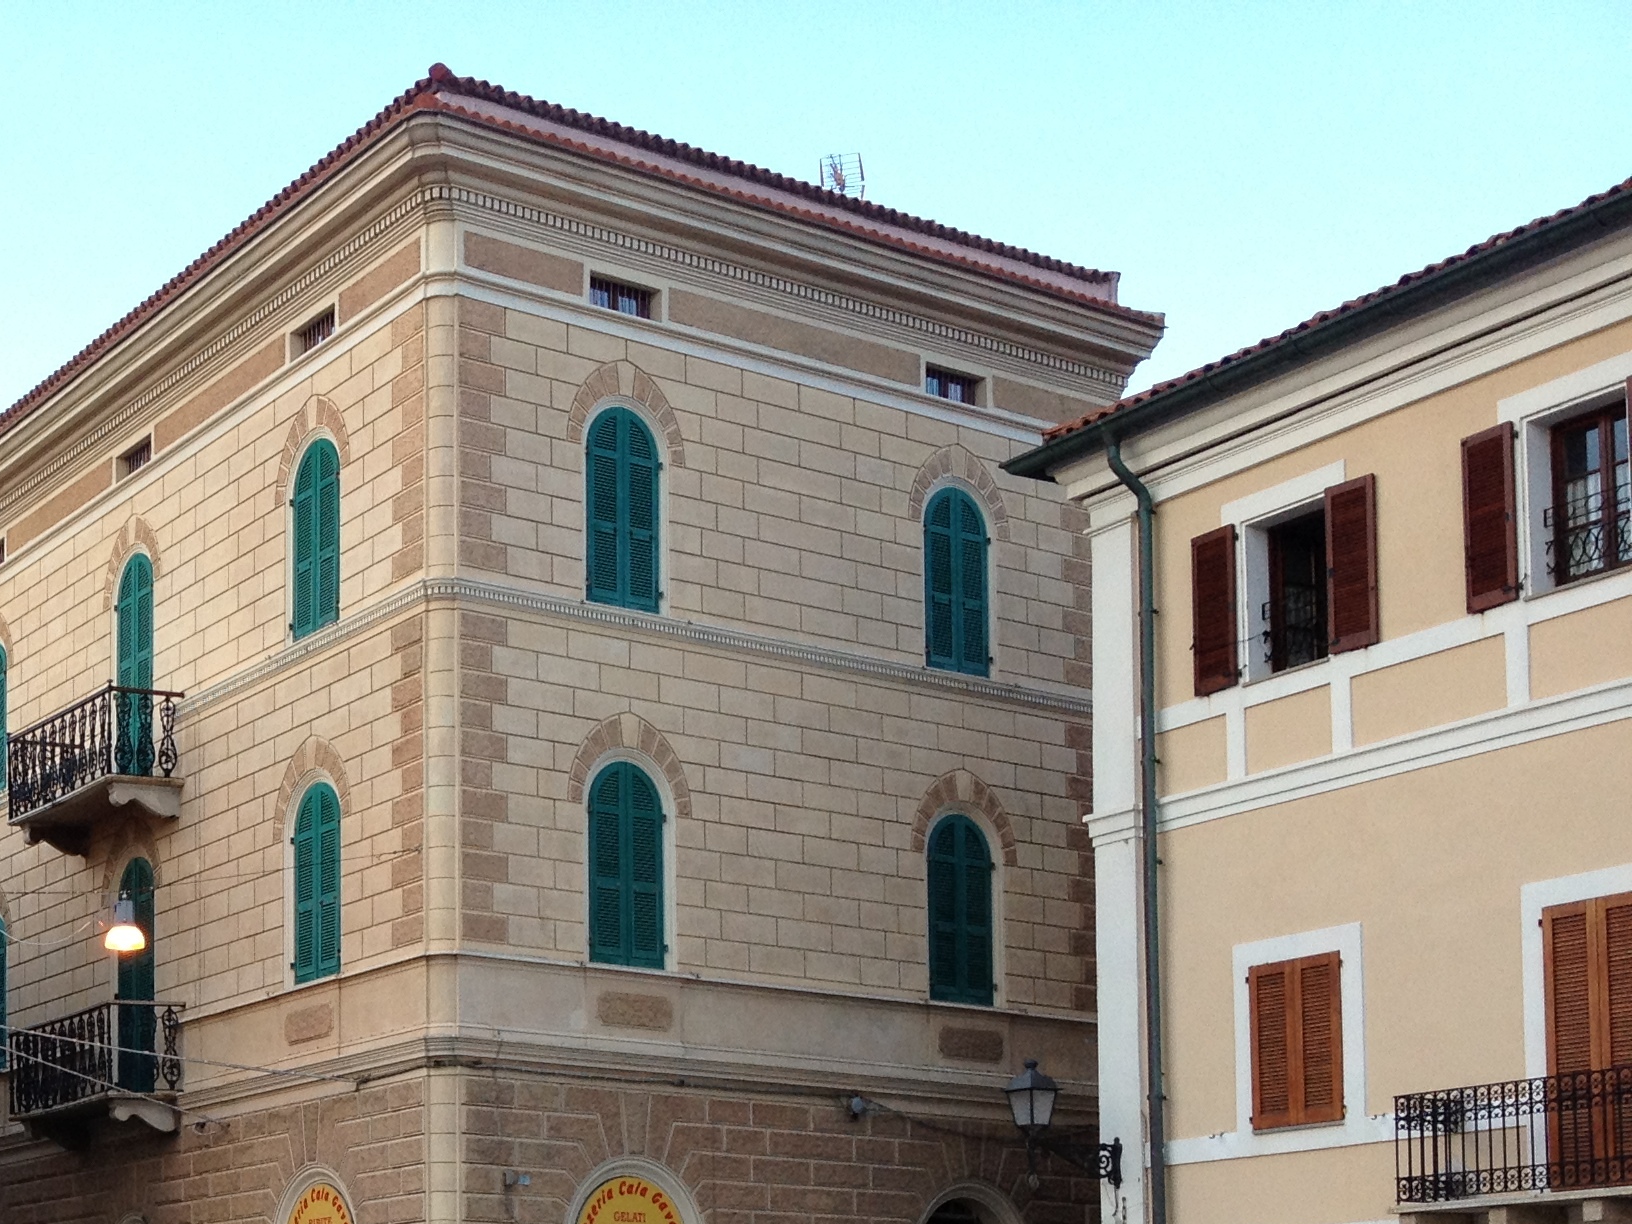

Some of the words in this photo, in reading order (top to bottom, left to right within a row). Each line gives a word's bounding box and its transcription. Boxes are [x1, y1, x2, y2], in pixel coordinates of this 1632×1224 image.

[310, 1187, 330, 1203] Cala
[618, 1180, 649, 1198] Cala
[613, 1211, 647, 1223] GELATI
